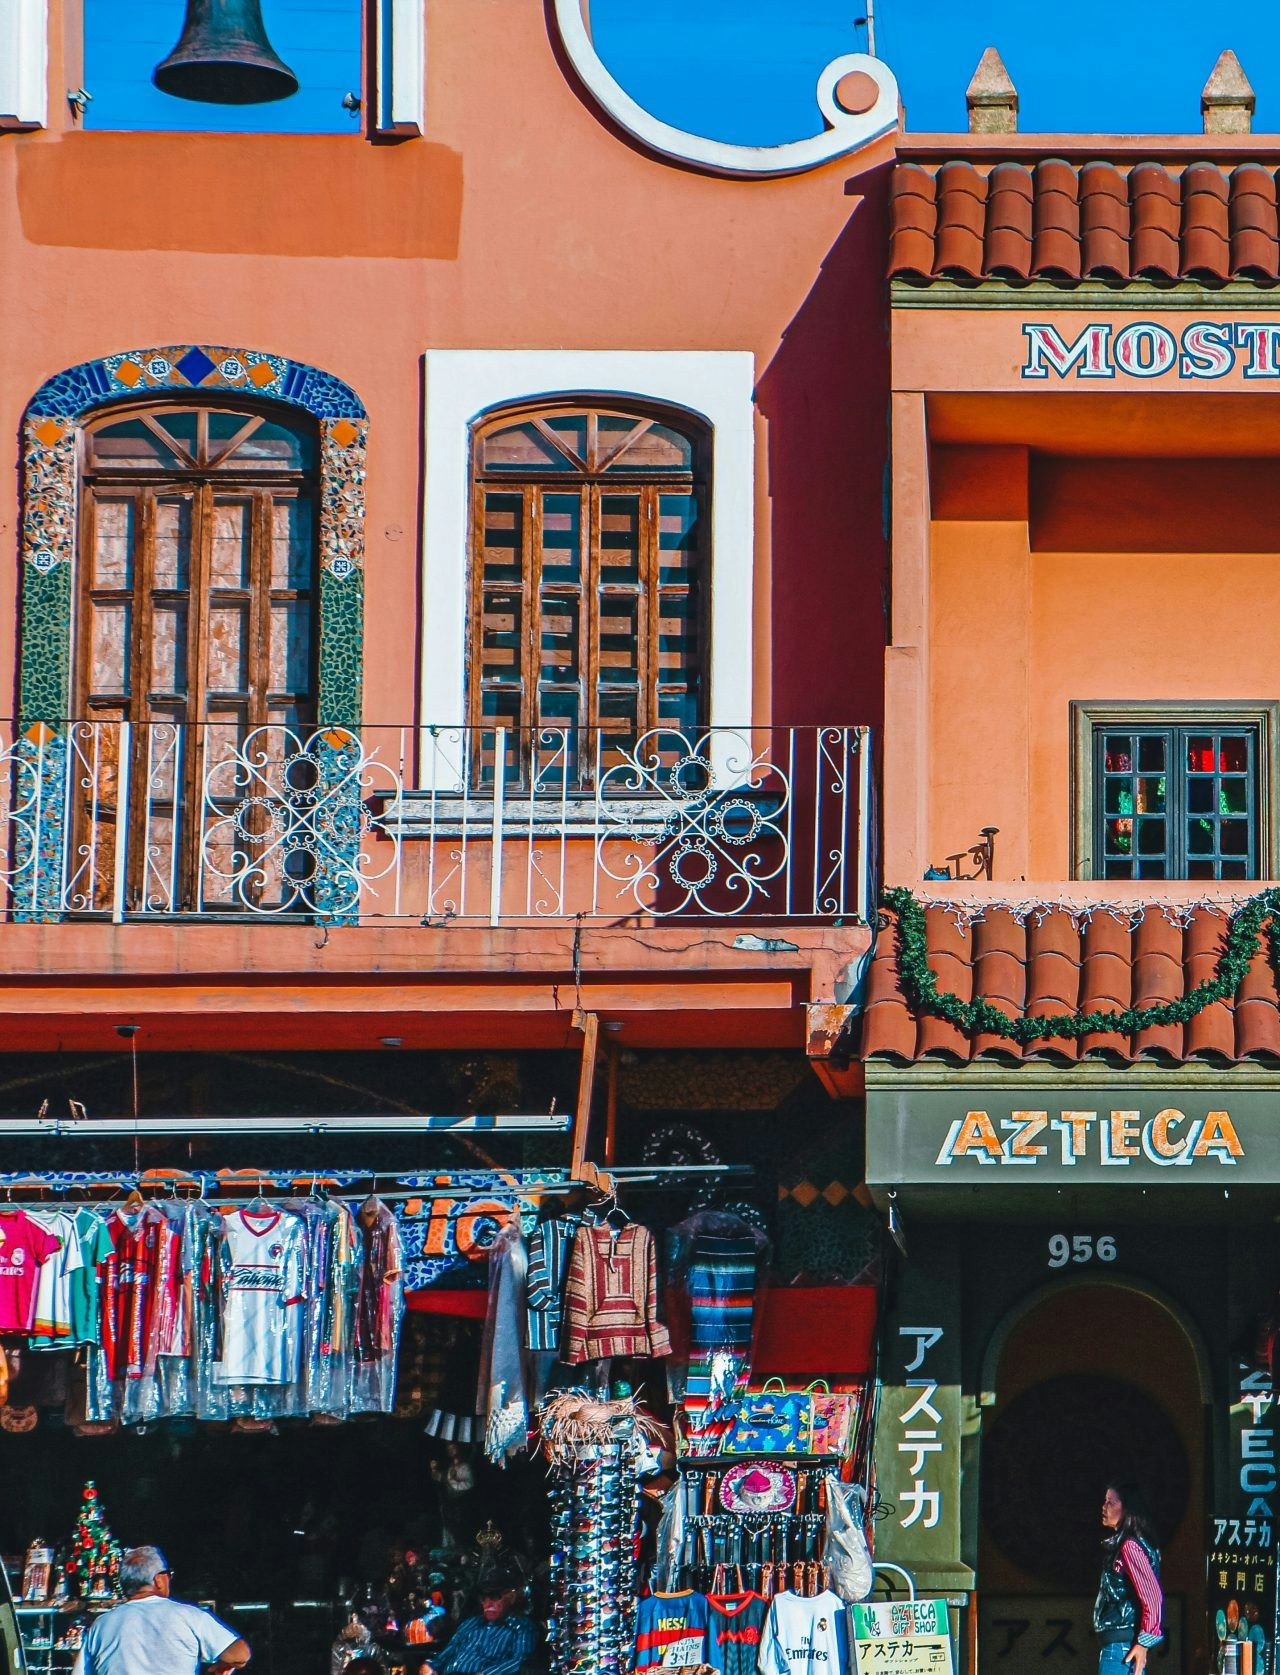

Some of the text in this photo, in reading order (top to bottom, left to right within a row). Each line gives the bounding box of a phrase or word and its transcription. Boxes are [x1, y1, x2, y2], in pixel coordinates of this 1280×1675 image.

[935, 1107, 1245, 1166] AZTECA
[1047, 1234, 1118, 1268] 956
[898, 1326, 944, 1530] アステカ
[1213, 1518, 1272, 1548] アステカ
[1218, 1570, 1265, 1593] 専門店
[891, 1603, 936, 1622] AZTECA
[893, 1620, 937, 1635] GIFT SHOP
[858, 1640, 914, 1660] アステカ
